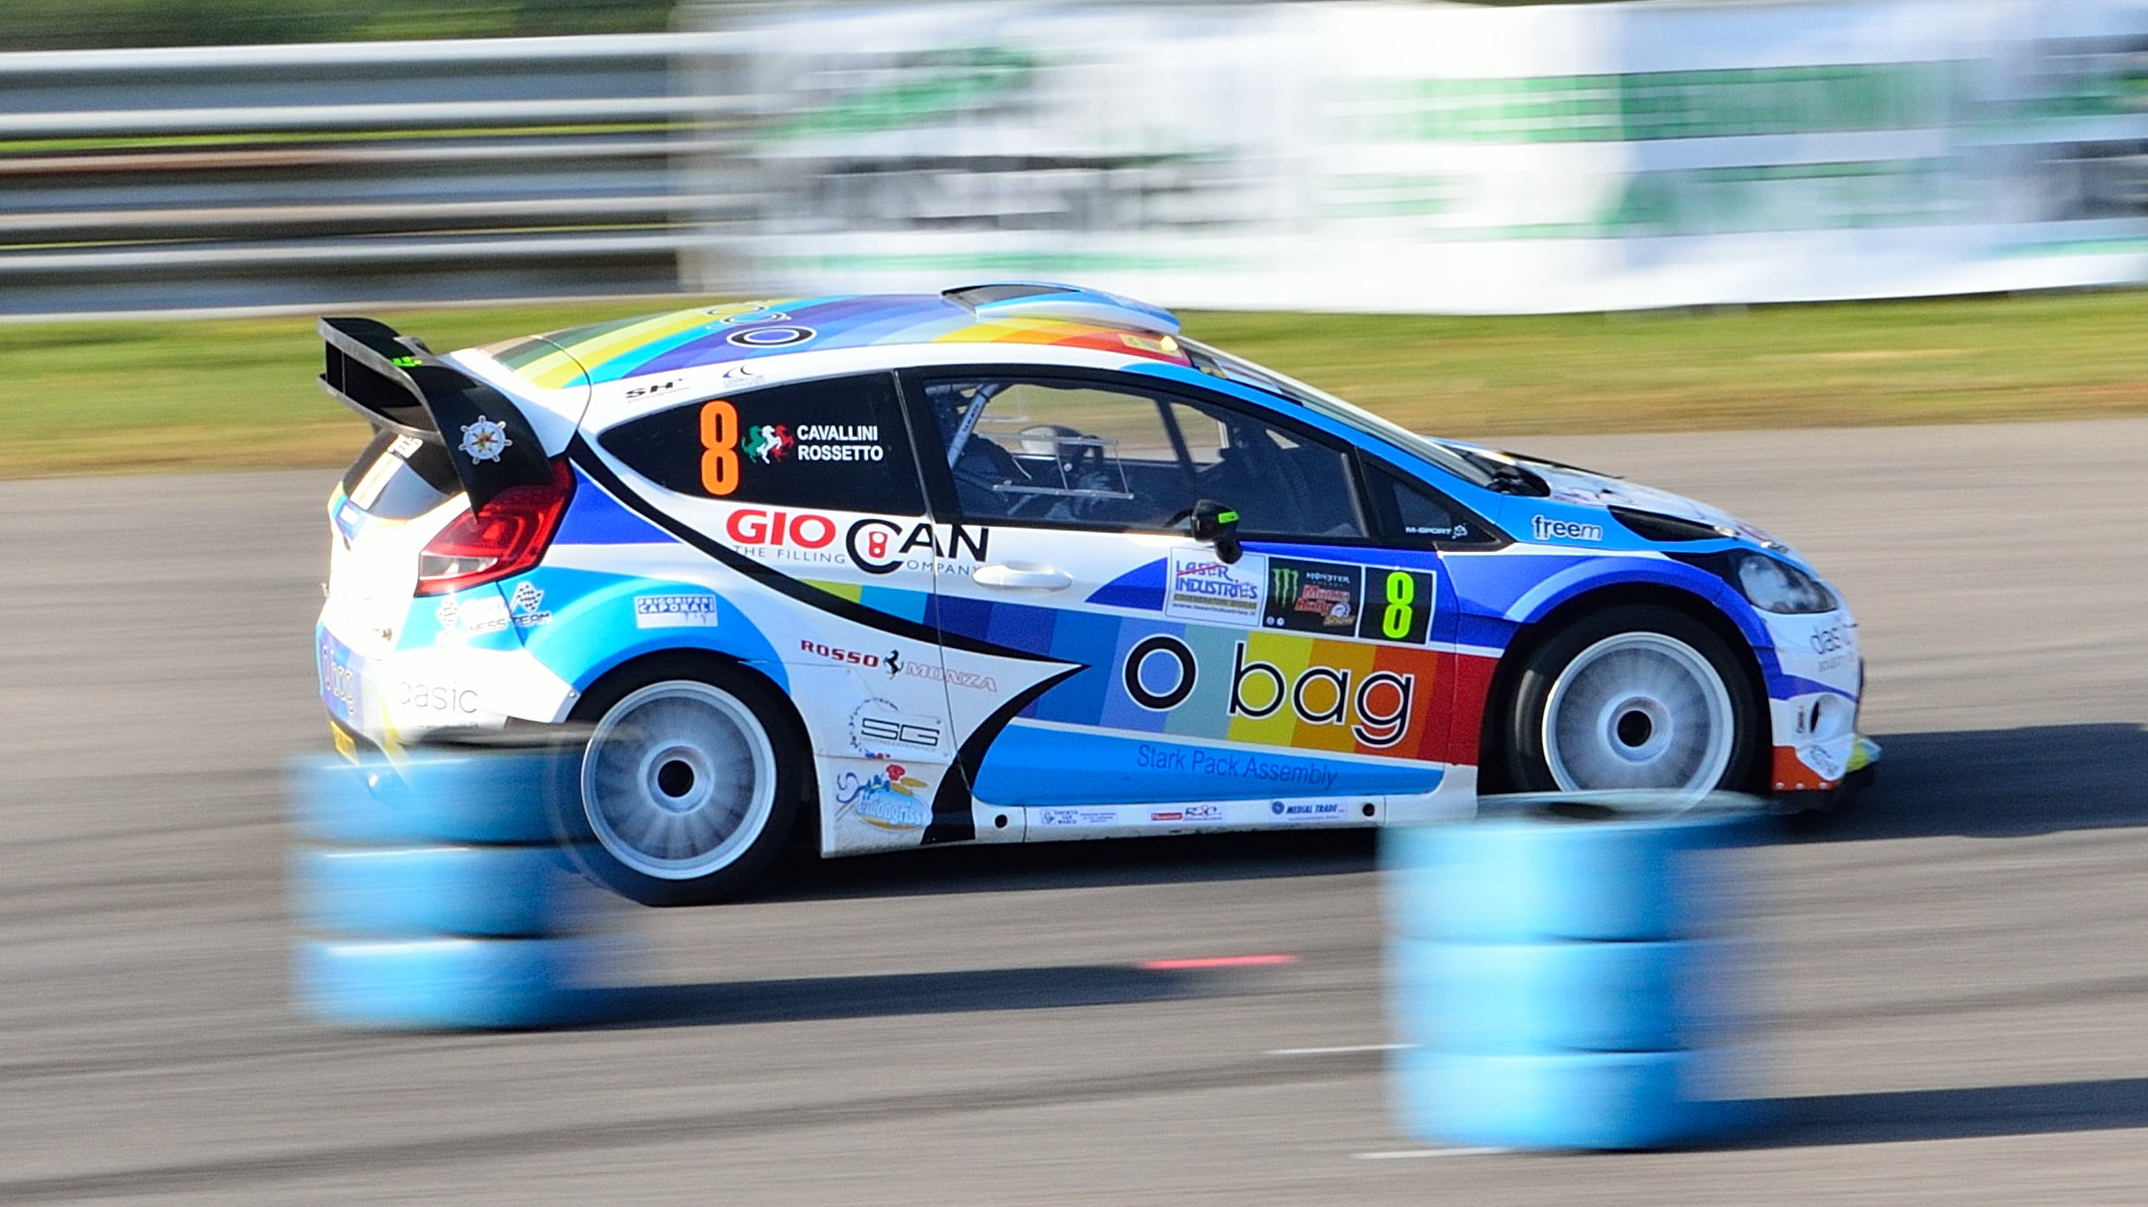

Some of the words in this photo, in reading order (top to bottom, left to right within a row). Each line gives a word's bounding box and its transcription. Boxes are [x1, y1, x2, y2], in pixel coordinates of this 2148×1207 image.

[700, 400, 740, 496] 8
[797, 424, 879, 441] CAVALLINI
[797, 444, 885, 461] ROSSETTO
[726, 509, 836, 549] GIO
[1405, 526, 1452, 535] M-SPORT
[1534, 516, 1602, 540] freem
[735, 545, 766, 558] THE
[777, 549, 846, 565] FILLING
[1305, 571, 1351, 584] MONSTER
[1382, 570, 1414, 639] 8
[801, 639, 879, 668] ROSSO
[906, 661, 997, 692] MONZA
[1123, 634, 1198, 712] O
[1228, 642, 1415, 748] bag
[1136, 744, 1186, 770] Stark
[1191, 750, 1239, 778] Pack
[1242, 758, 1338, 791] Assembly
